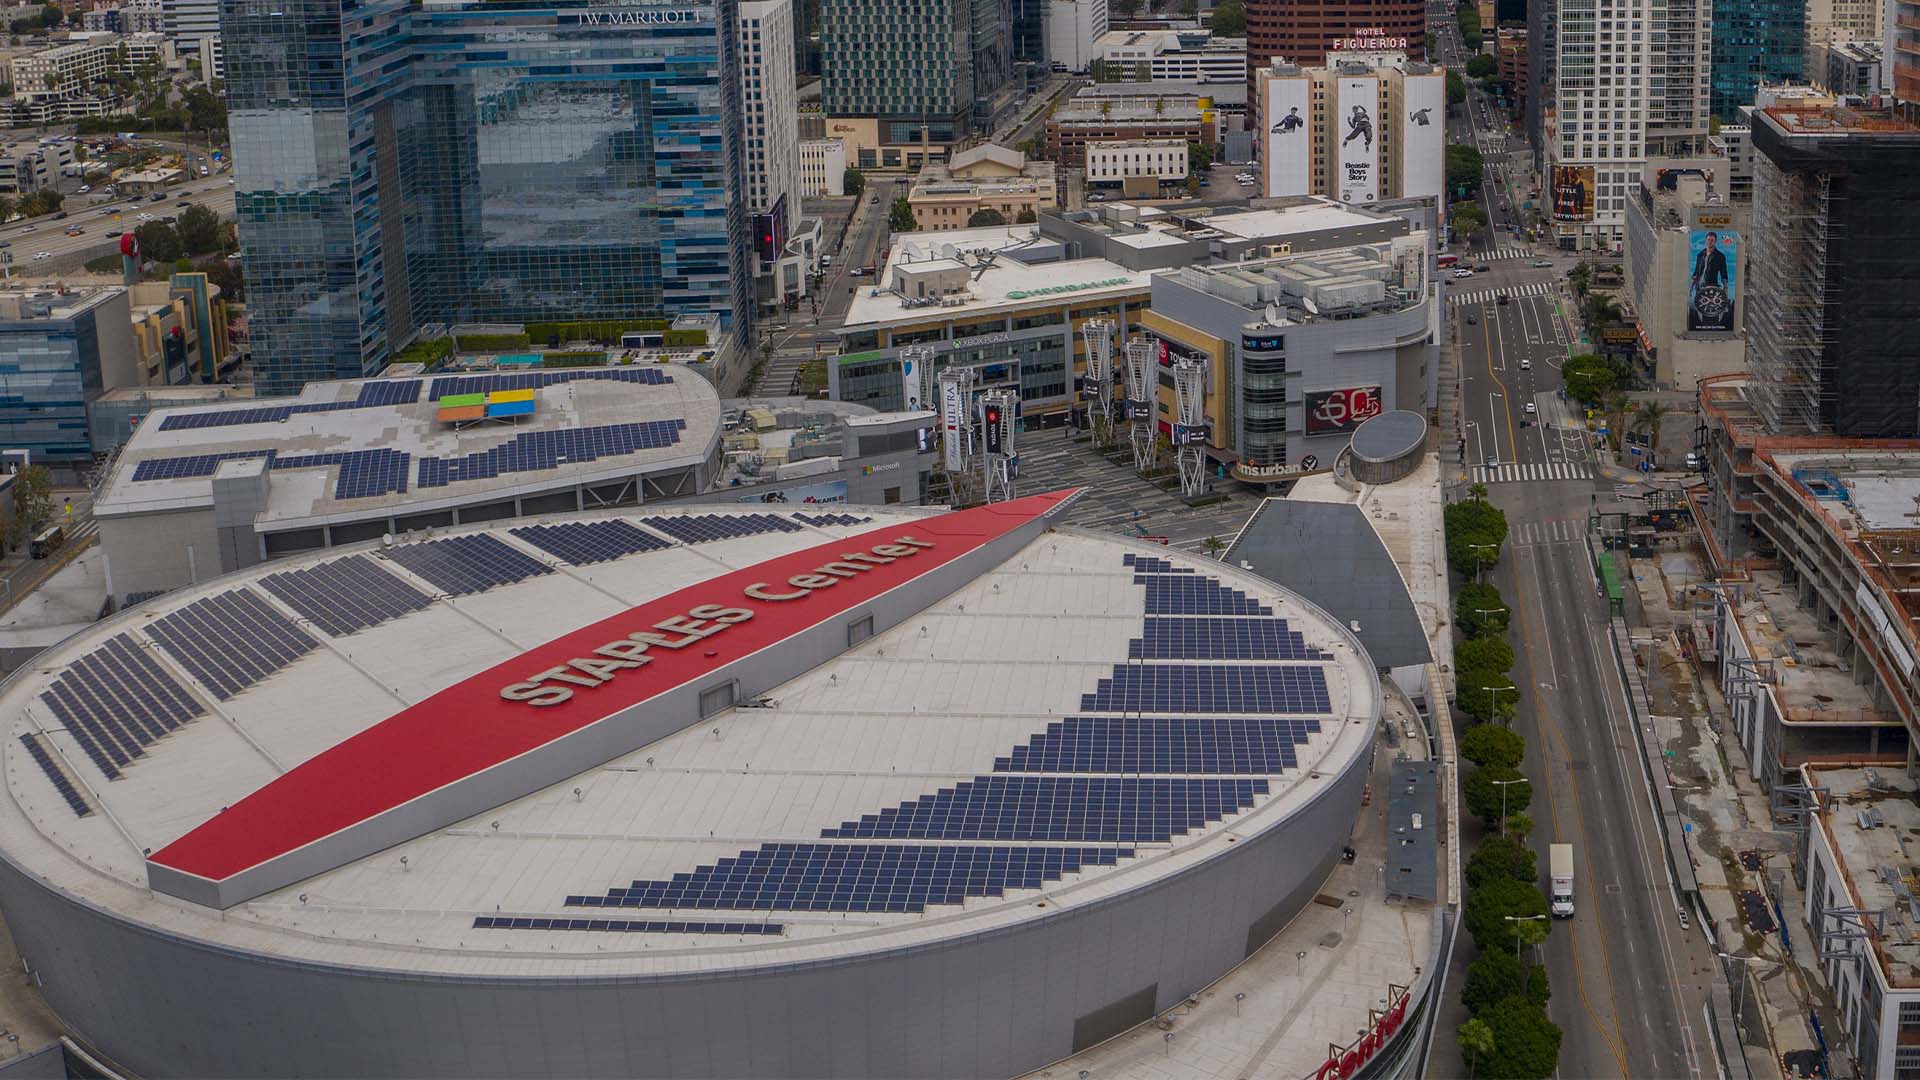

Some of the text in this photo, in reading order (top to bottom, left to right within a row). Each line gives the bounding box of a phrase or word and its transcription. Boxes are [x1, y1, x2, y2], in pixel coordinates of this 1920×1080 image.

[578, 9, 703, 27] JW MARRIOTT
[1355, 27, 1386, 36] HOTEL
[1333, 38, 1408, 49] FIGUEROA
[1349, 168, 1366, 176] Boys
[962, 336, 984, 346] XBOX
[946, 387, 957, 424] ULTRA
[872, 462, 900, 473] Microsoft
[1260, 463, 1303, 477] urban
[500, 535, 936, 707] STAPLES Center
